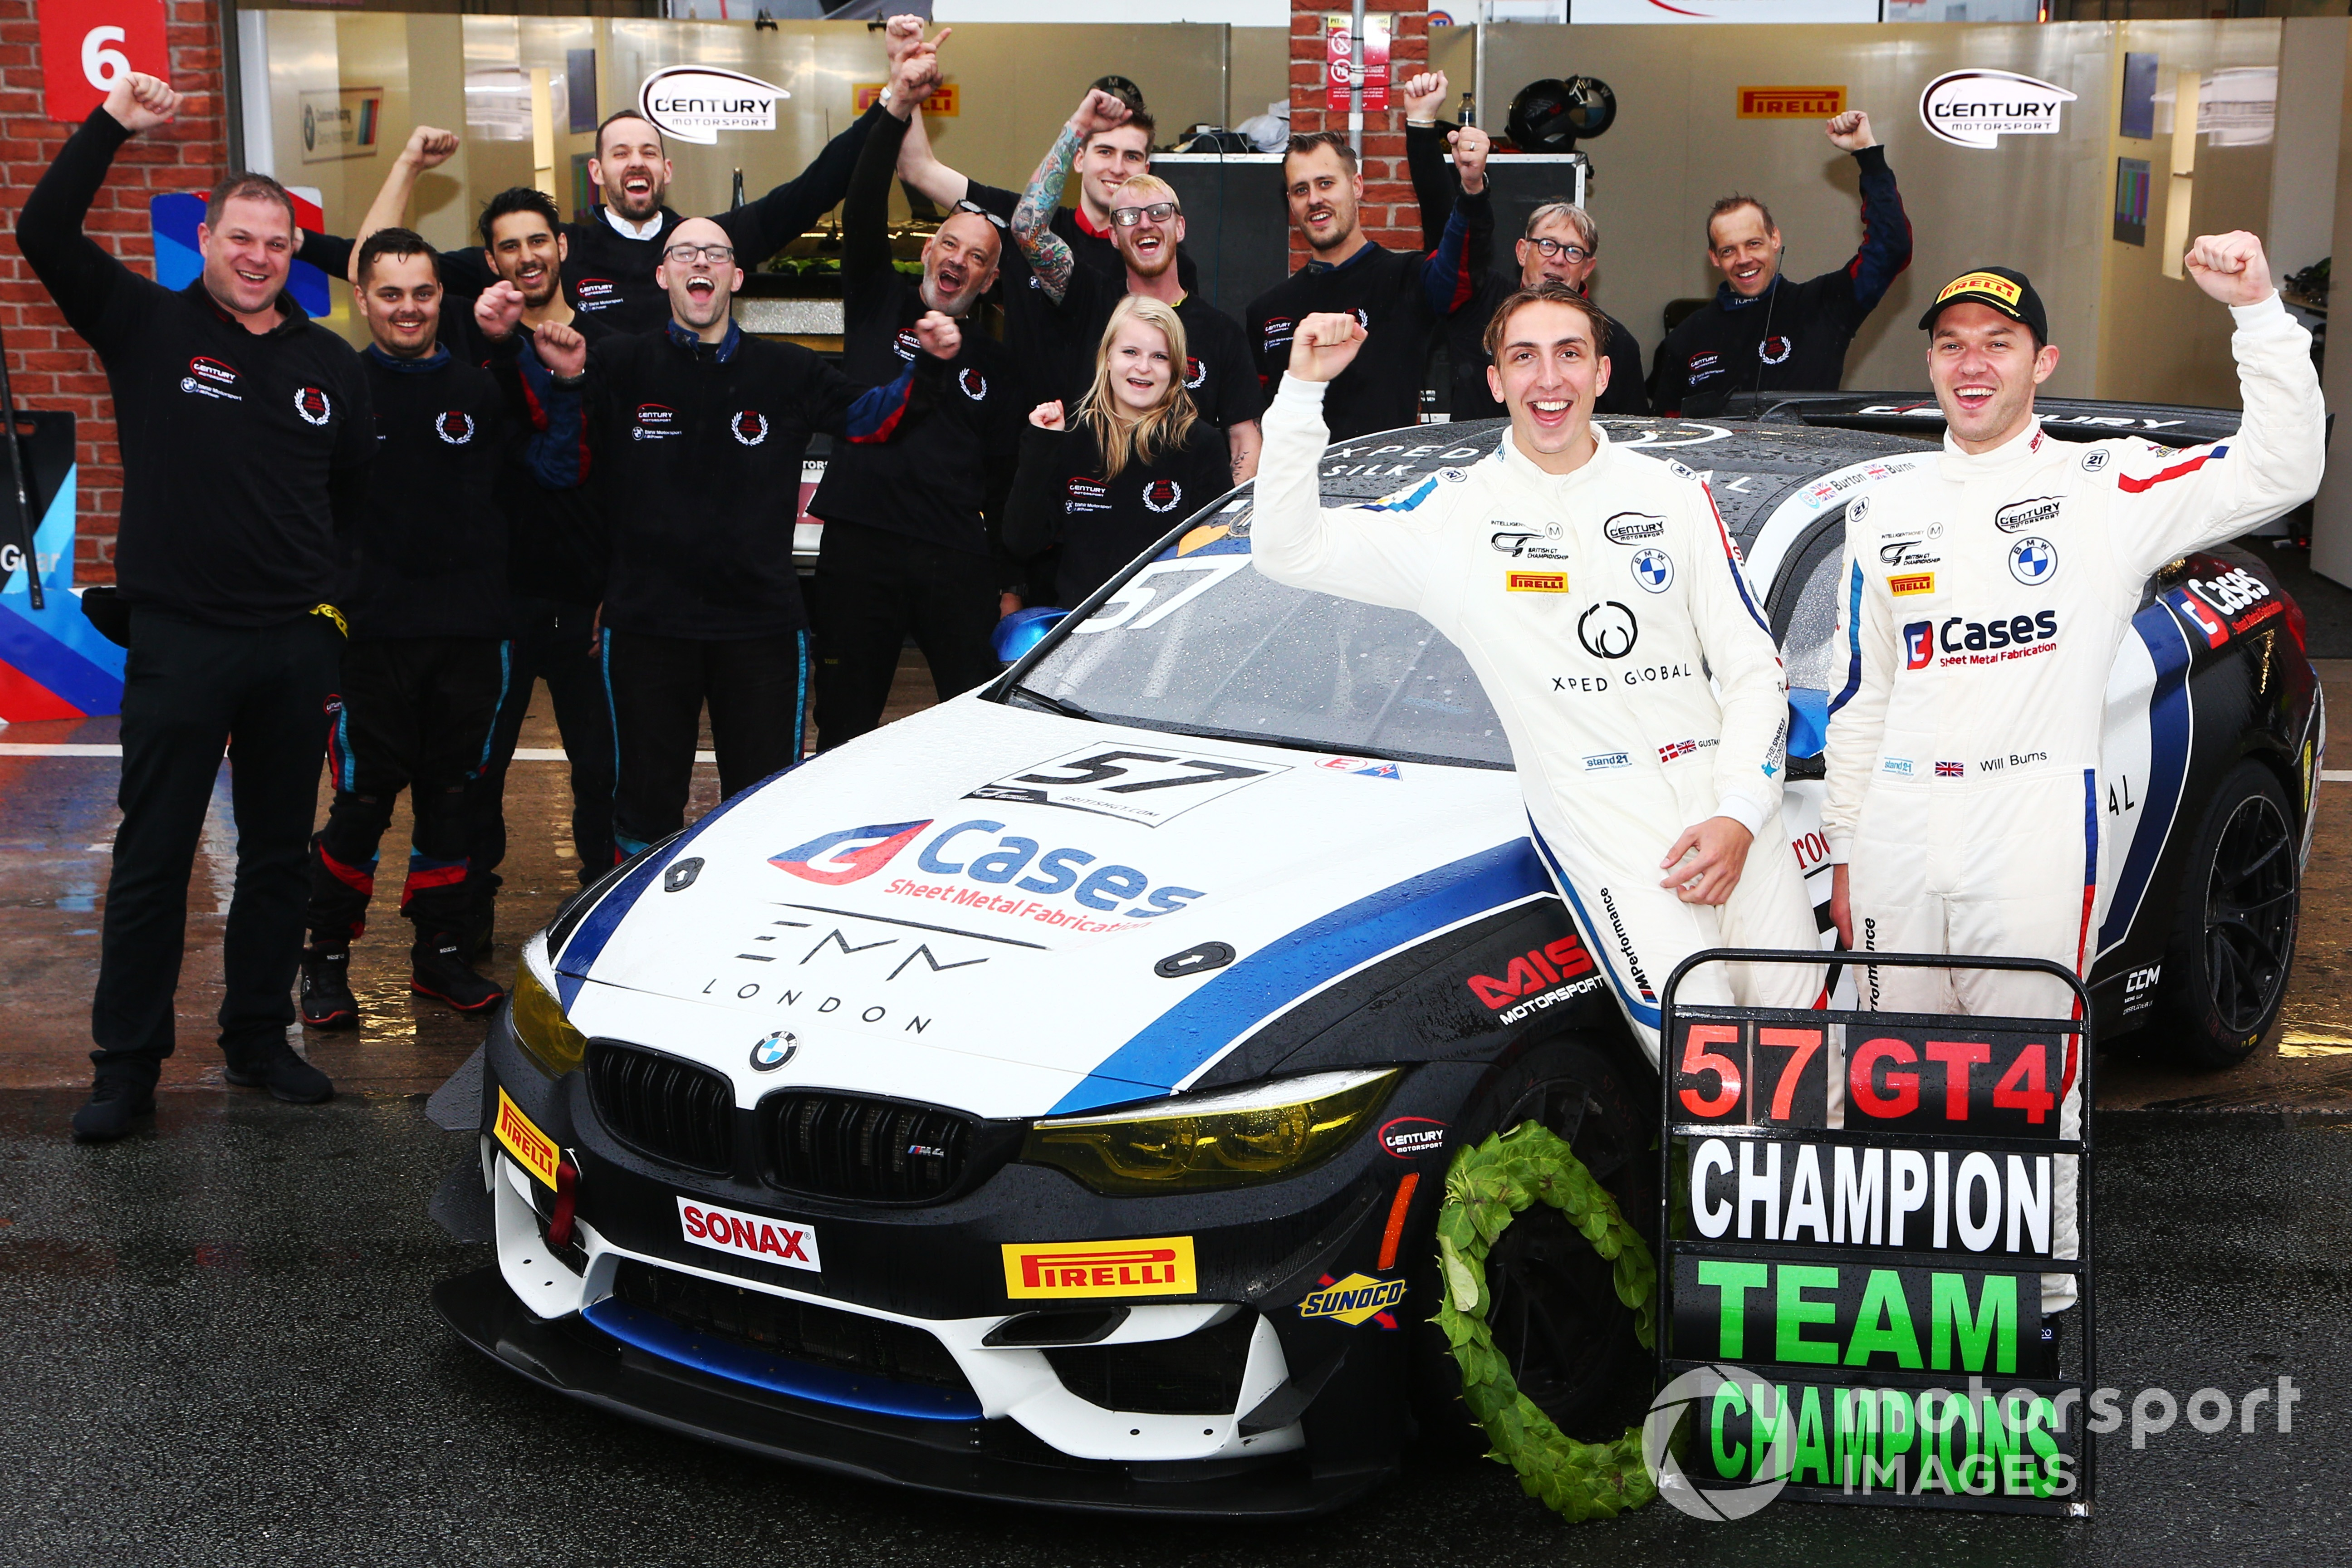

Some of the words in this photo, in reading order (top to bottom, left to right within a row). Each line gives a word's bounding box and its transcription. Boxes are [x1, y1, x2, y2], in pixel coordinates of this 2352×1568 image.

[81, 26, 131, 92] 6
[655, 98, 772, 113] CENTURY
[1743, 90, 1840, 113] PIRELLI
[1935, 101, 2057, 118] CENTURY
[672, 118, 769, 127] MOTORSPORT
[1951, 122, 2051, 131] MOTORSPORT
[579, 284, 613, 294] CENTURY
[1939, 275, 2015, 300] PIRELLI
[1265, 321, 1291, 332] CENTURY
[193, 363, 235, 380] CENTURY
[1690, 355, 1719, 368] CENTURY
[1883, 461, 1916, 474] Burns
[2088, 455, 2103, 465] 21
[1069, 485, 1106, 494] CENTURY
[1829, 473, 1867, 491] Burton
[1999, 501, 2061, 525] CENTURY
[2009, 512, 2060, 530] MOTORSPORT
[1610, 521, 1664, 537] CENTURY
[1620, 530, 1664, 541] MOTORSPORT
[1634, 550, 1666, 564] BMW
[2013, 539, 2050, 556] BMW
[1903, 556, 1941, 566] CHAMPIONSHIP
[1511, 574, 1563, 589] PIRELLI
[1891, 576, 1931, 593] PIRELLI
[2188, 568, 2270, 616] Cases
[1071, 554, 1253, 633] 57
[1940, 610, 2058, 654] Cases
[1940, 654, 1967, 668] Sheet
[1970, 652, 1998, 665] Metal
[2000, 641, 2057, 663] Fabrication
[1552, 677, 1607, 692] XPED
[1624, 663, 1691, 686] GLOBAL
[1012, 751, 1271, 794] 57
[1980, 753, 2004, 773] Will
[2010, 750, 2047, 766] Burns
[1060, 795, 1161, 818] BRITISHGT.COM
[917, 819, 1207, 919] Cases
[883, 878, 954, 902] Sheet
[950, 888, 1025, 920] Metal
[1018, 901, 1151, 935] Fabrication
[2126, 965, 2161, 993] CCM
[702, 978, 932, 1035] LONDON
[1499, 975, 1604, 1027] MOTORSPORT
[763, 1030, 798, 1048] BMW
[1849, 1037, 2055, 1125] GT4
[500, 1100, 553, 1179] PIRELLI
[1385, 1129, 1444, 1147] CENTURY
[1396, 1142, 1443, 1154] MOTORSPORT
[1690, 1136, 2052, 1255] CHAMPION
[1021, 1249, 1176, 1288] PIRELLI
[1306, 1279, 1405, 1313] SUNOCO
[1698, 1259, 2019, 1374] TEAM
[1709, 1380, 2062, 1499] CHAMPIONS
